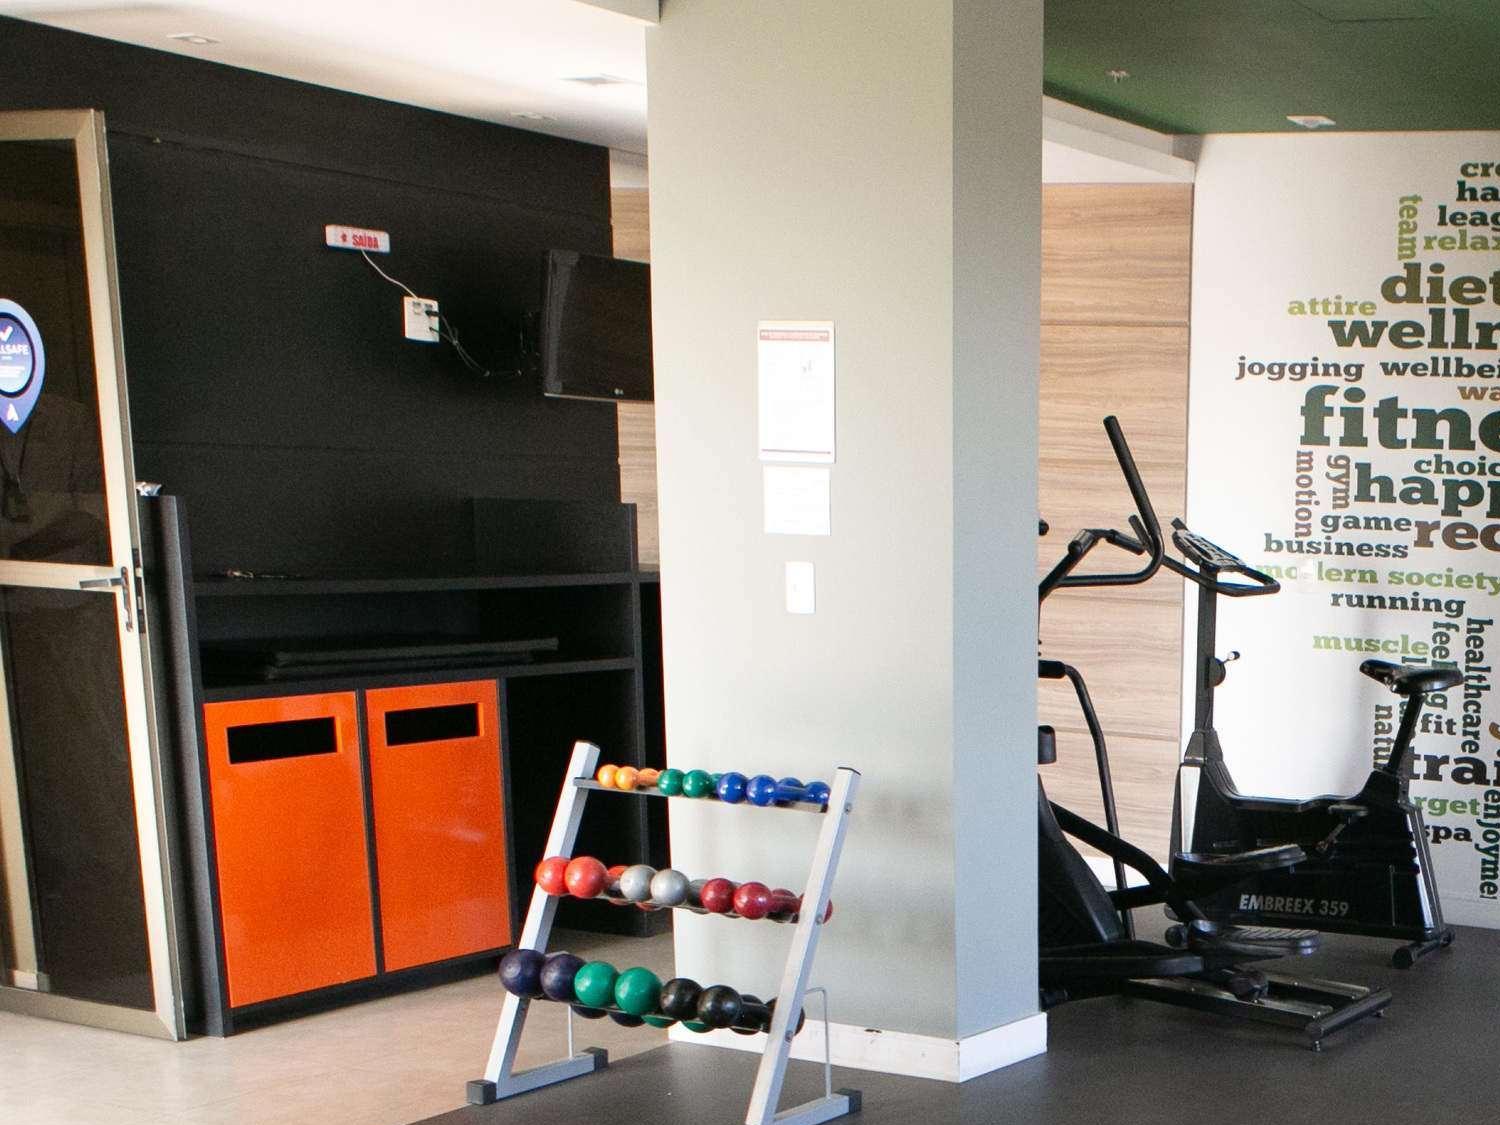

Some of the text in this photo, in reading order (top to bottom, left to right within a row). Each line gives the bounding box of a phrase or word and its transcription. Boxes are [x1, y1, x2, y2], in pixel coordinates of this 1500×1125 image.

[1398, 194, 1422, 261] team
[1287, 295, 1376, 317] attire
[1235, 356, 1364, 382] jogging
[1294, 450, 1320, 538] motion
[1326, 455, 1350, 510] gym
[1320, 514, 1412, 533] game
[1264, 533, 1408, 559] business
[1331, 591, 1466, 618] running
[1313, 634, 1429, 655] muscle
[1424, 620, 1460, 711] feelg
[1461, 617, 1494, 753] healthcare
[1420, 713, 1456, 735] fit
[1240, 894, 1349, 916] EMBREEX 359
